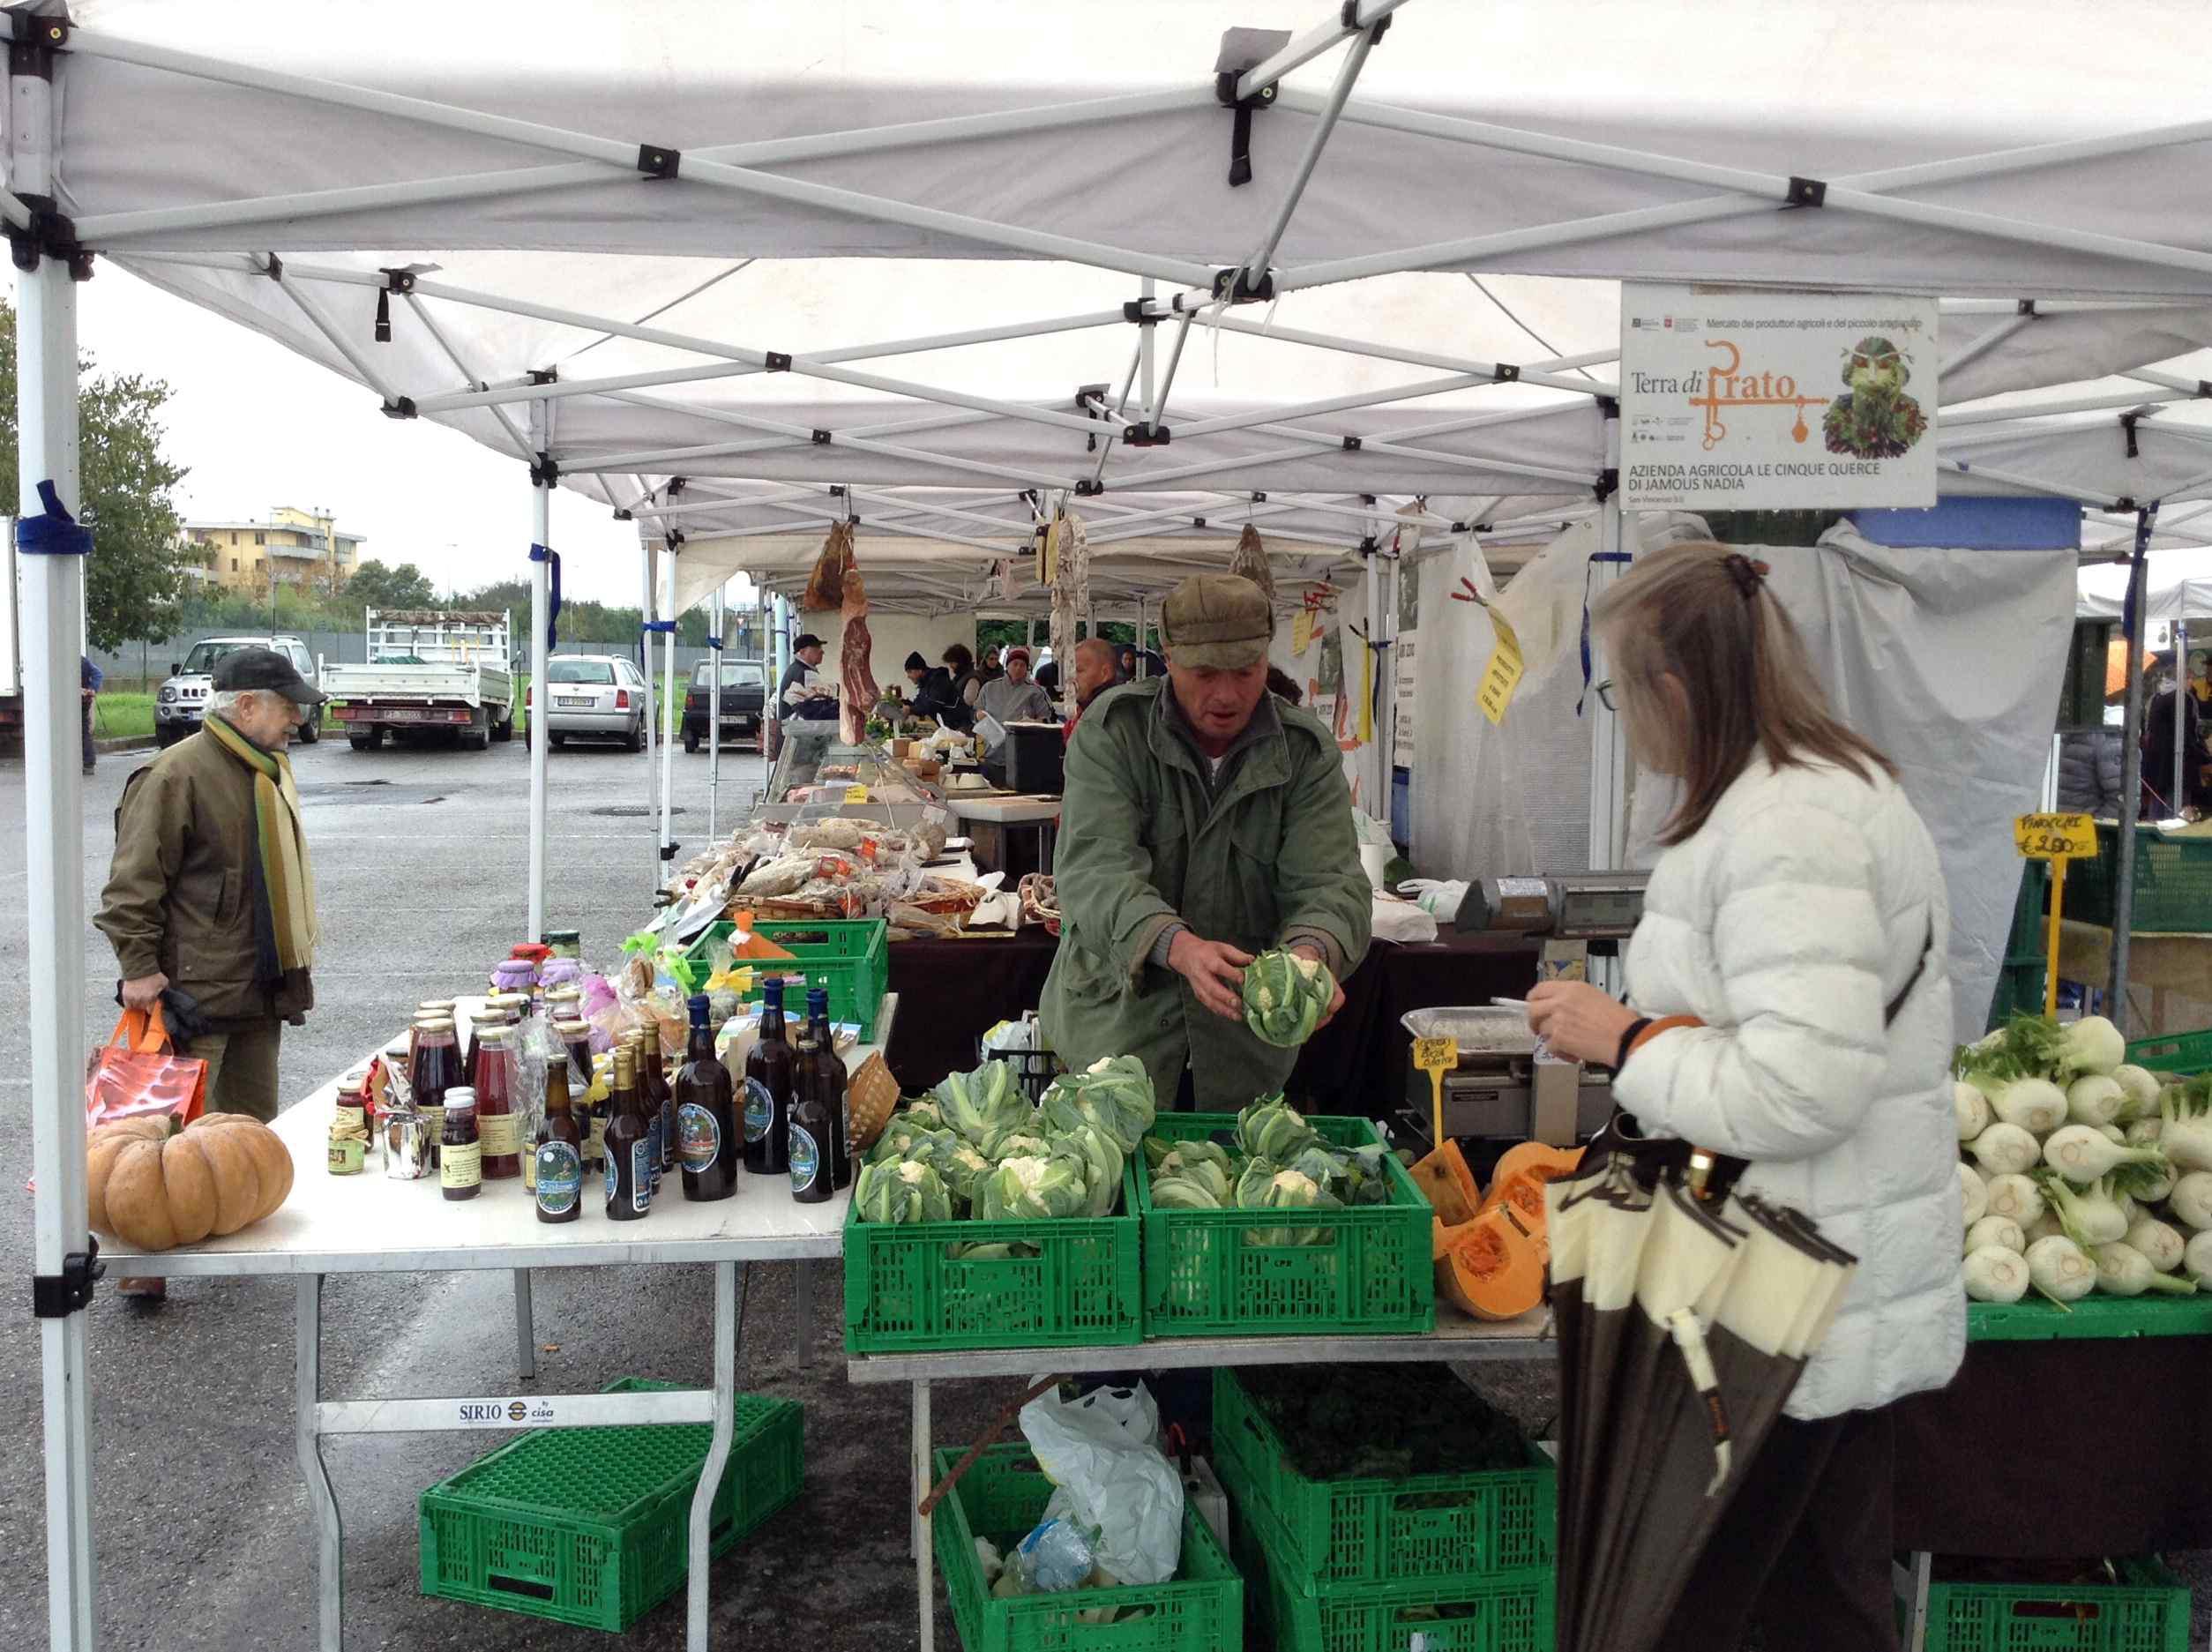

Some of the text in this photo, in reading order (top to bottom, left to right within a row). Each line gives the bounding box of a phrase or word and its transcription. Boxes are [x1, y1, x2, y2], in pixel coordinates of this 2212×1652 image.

[1707, 318, 1740, 328] Mercato
[1742, 318, 1754, 328] dei
[1756, 318, 1794, 331] produttori
[1797, 318, 1825, 331] agricoli
[1834, 318, 1846, 328] del
[1848, 318, 1878, 332] piccolo
[1631, 370, 1678, 393] Terra
[1682, 370, 1702, 393] di
[1629, 462, 1880, 477] AZIENDA AGRICOLA LE CINQUE QUERCE
[1628, 477, 1745, 491] DI JAMOUS NADIA
[460, 1404, 554, 1420] SIRIO cisa
